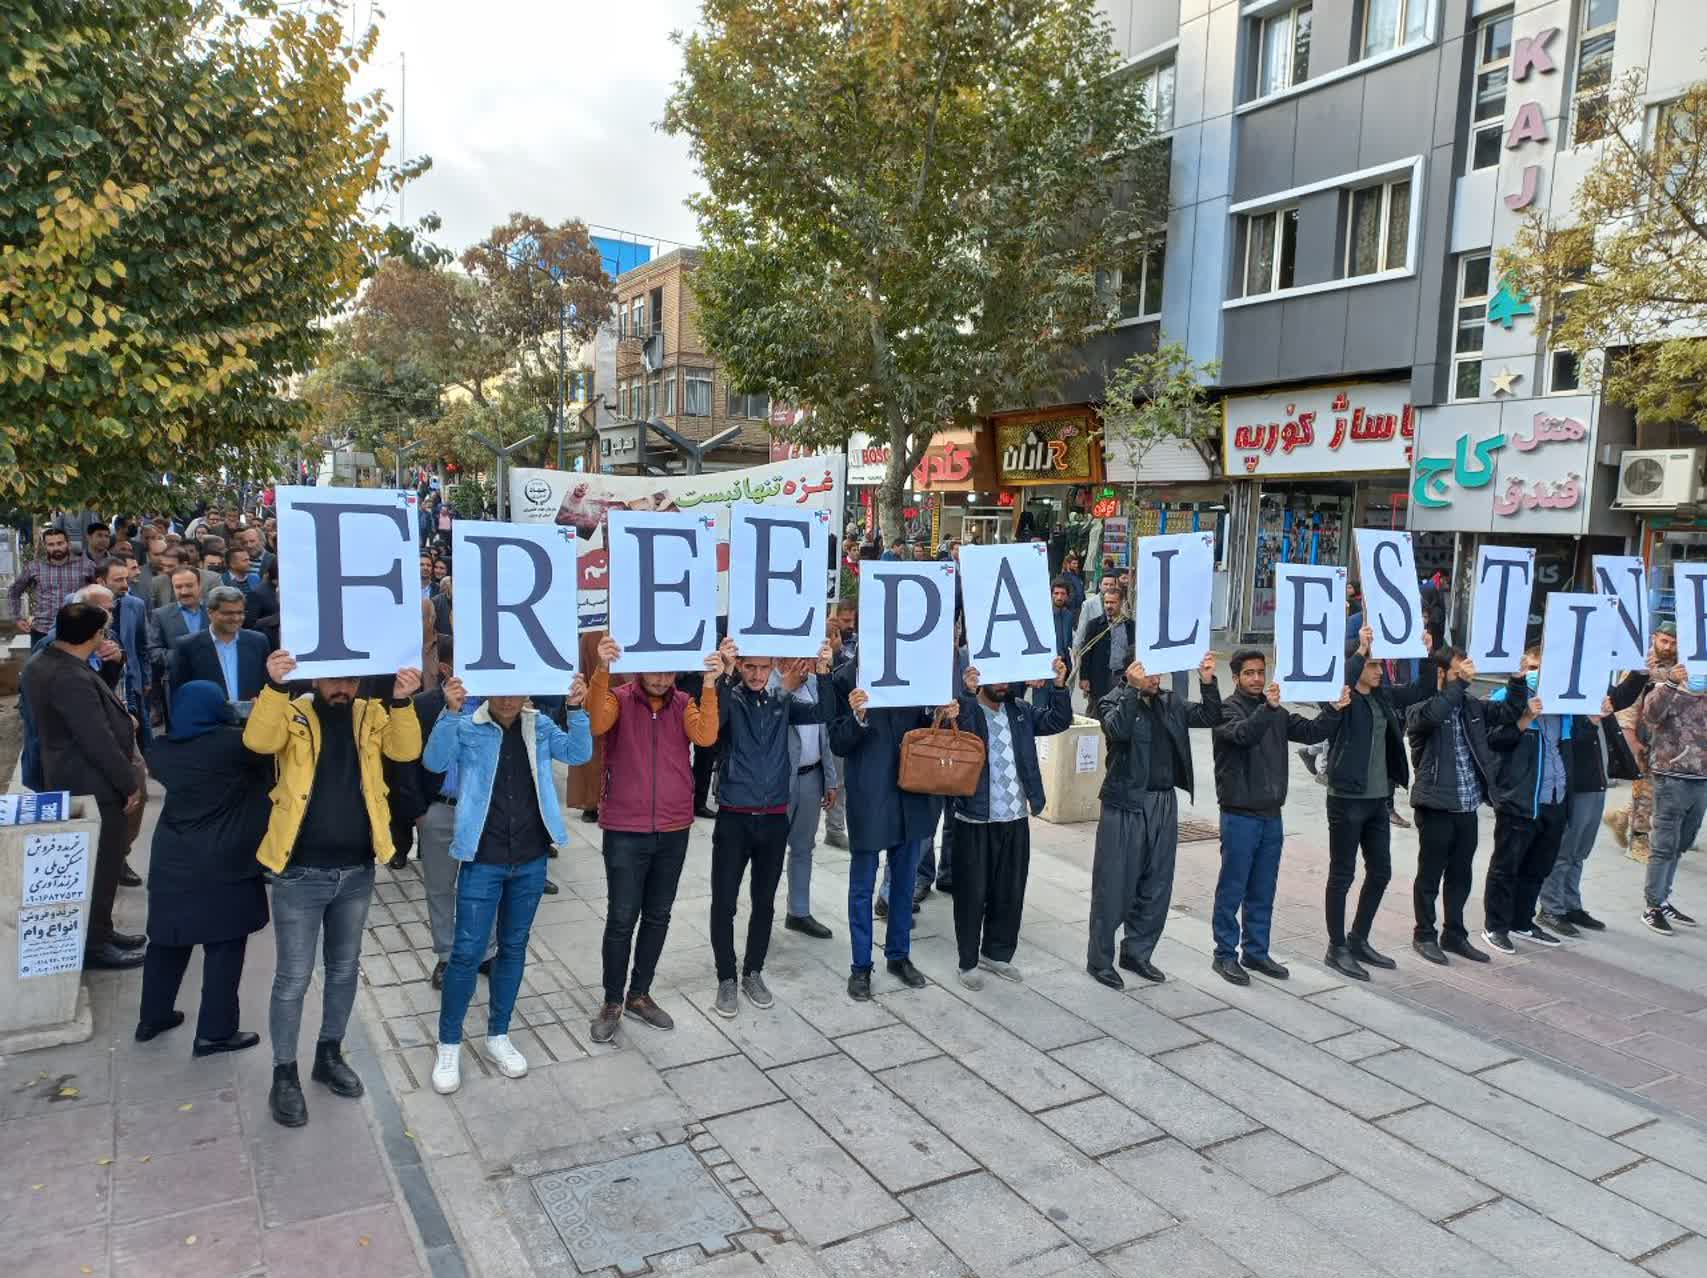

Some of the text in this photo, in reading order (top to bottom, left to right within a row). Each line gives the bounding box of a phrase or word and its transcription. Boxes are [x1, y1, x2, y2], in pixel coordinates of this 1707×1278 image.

[1504, 27, 1560, 210] KAJ
[1412, 434, 1507, 508] کاج
[1512, 412, 1587, 452] هتل
[674, 470, 834, 508] غزه تنها نیست
[1494, 472, 1581, 516] فندق
[291, 503, 410, 661] F
[464, 536, 570, 671] R
[624, 527, 706, 653] E
[740, 517, 816, 637] E
[973, 557, 1052, 660] A
[1150, 550, 1199, 650] L
[1373, 541, 1413, 645] S
[1481, 559, 1529, 658] T
[1597, 566, 1643, 657] N
[871, 574, 942, 687] P
[1284, 576, 1337, 682] E
[1559, 606, 1597, 700] I
